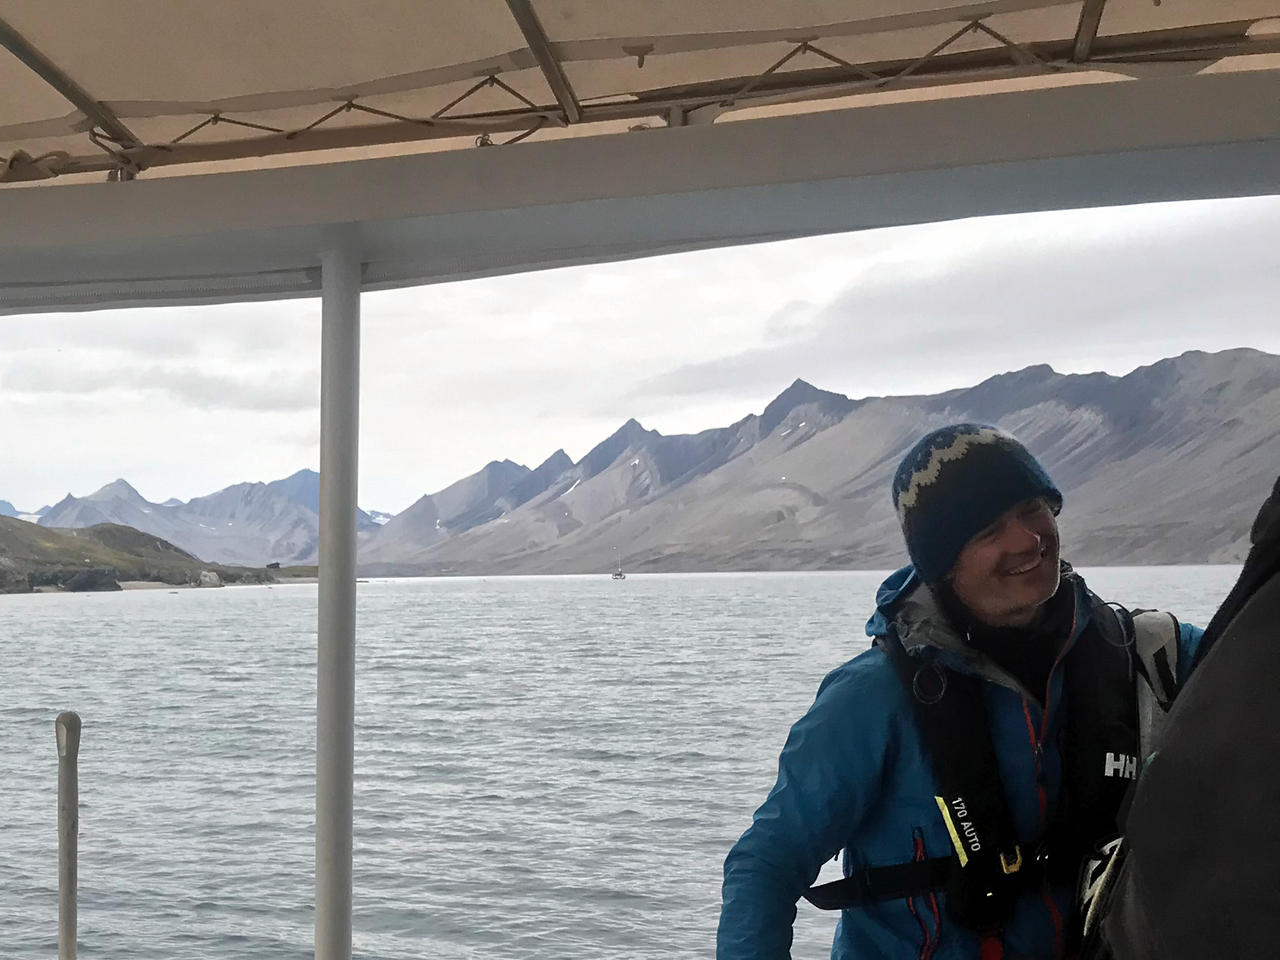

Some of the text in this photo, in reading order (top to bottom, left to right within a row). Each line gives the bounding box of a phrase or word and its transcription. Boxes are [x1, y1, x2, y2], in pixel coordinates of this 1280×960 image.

[1104, 752, 1137, 780] HH
[951, 797, 981, 852] 170 AUTO
